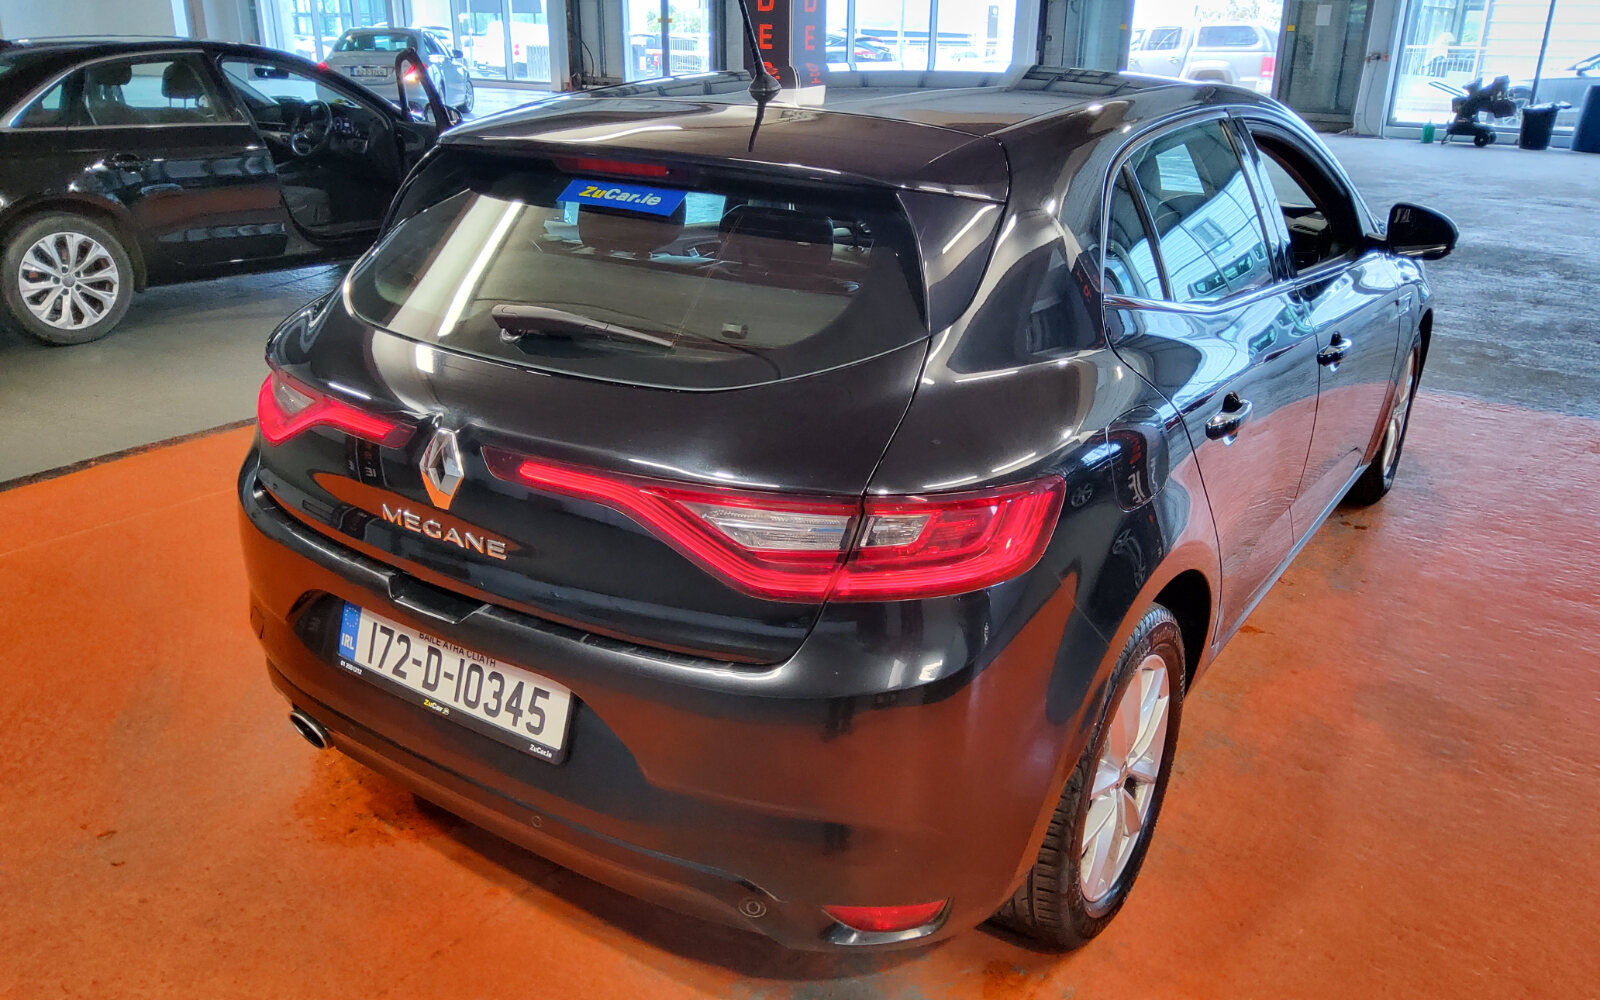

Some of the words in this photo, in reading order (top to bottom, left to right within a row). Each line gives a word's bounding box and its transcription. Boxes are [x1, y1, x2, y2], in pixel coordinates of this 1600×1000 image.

[579, 186, 661, 205] ZuCar.ie
[382, 503, 507, 560] MEGANE
[341, 633, 355, 650] IRL
[466, 651, 496, 668] CLIATH
[368, 622, 550, 736] 172-D-10345
[529, 744, 552, 758] ZuCar.ie
